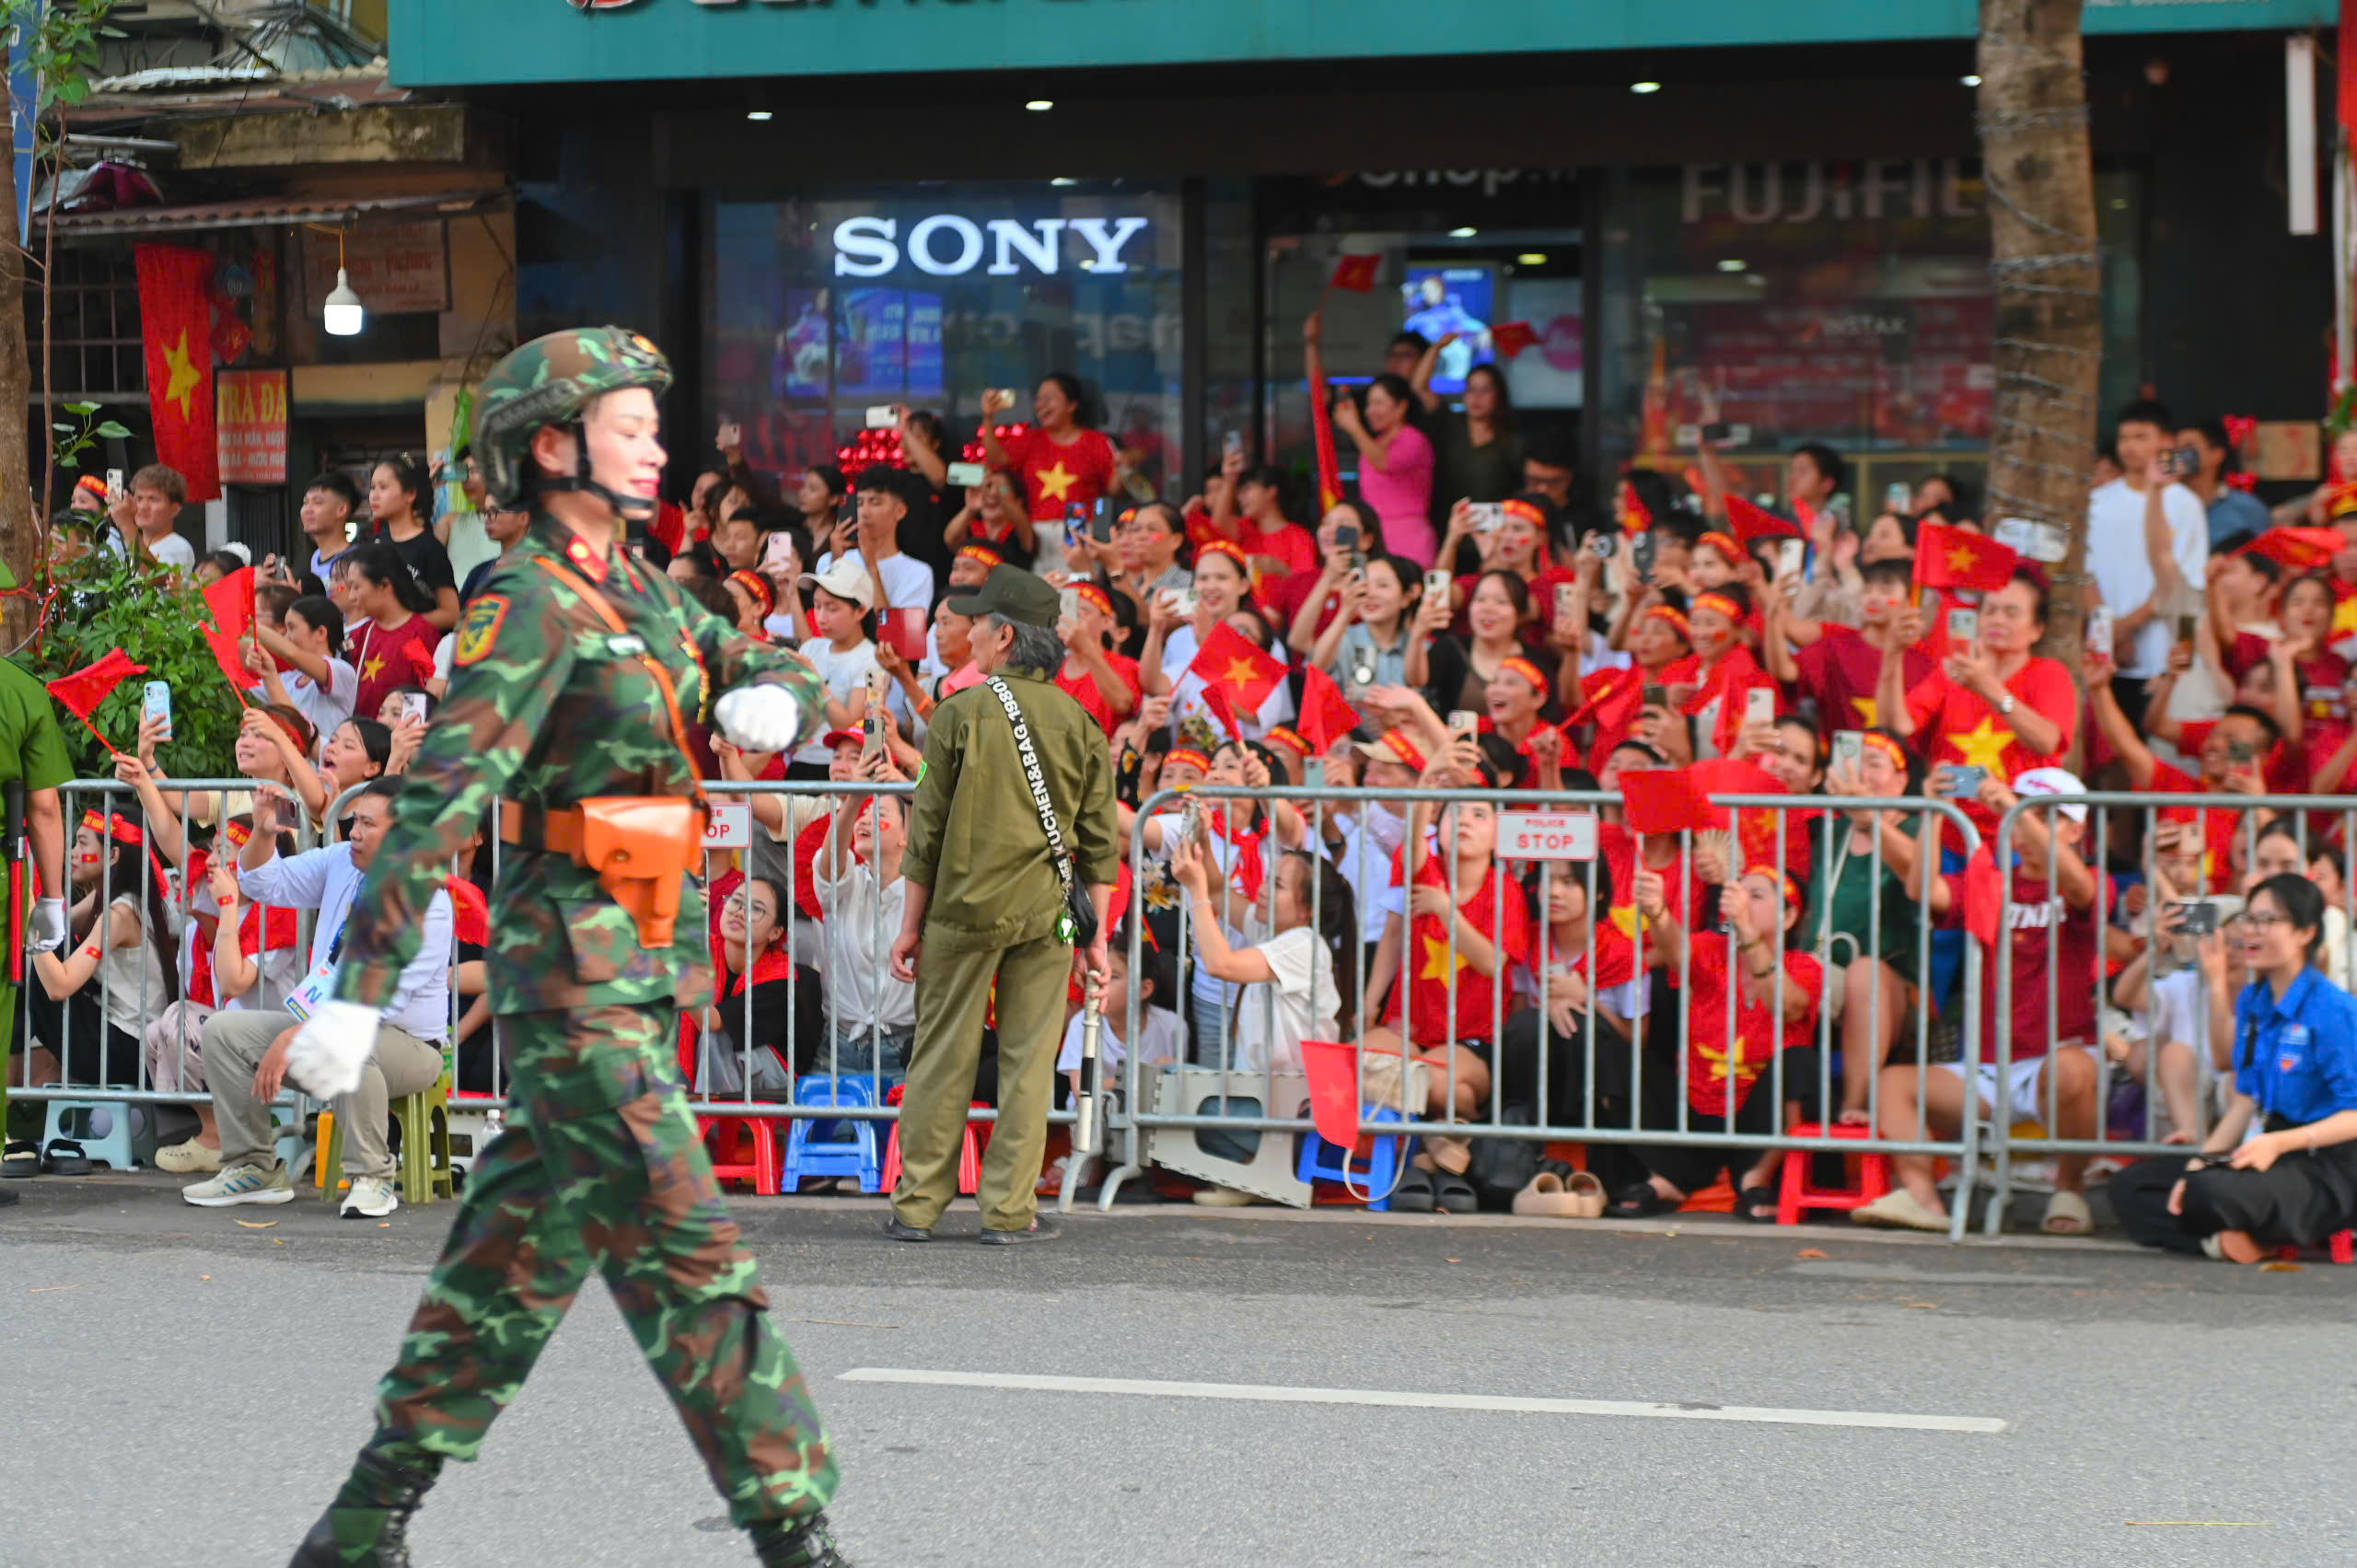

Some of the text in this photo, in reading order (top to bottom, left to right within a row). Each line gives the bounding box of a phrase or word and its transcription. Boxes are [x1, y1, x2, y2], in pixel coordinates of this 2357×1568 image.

[833, 215, 1148, 277] SONY
[706, 823, 730, 839] OP
[1517, 833, 1574, 850] STOP
[304, 985, 322, 1005] N
